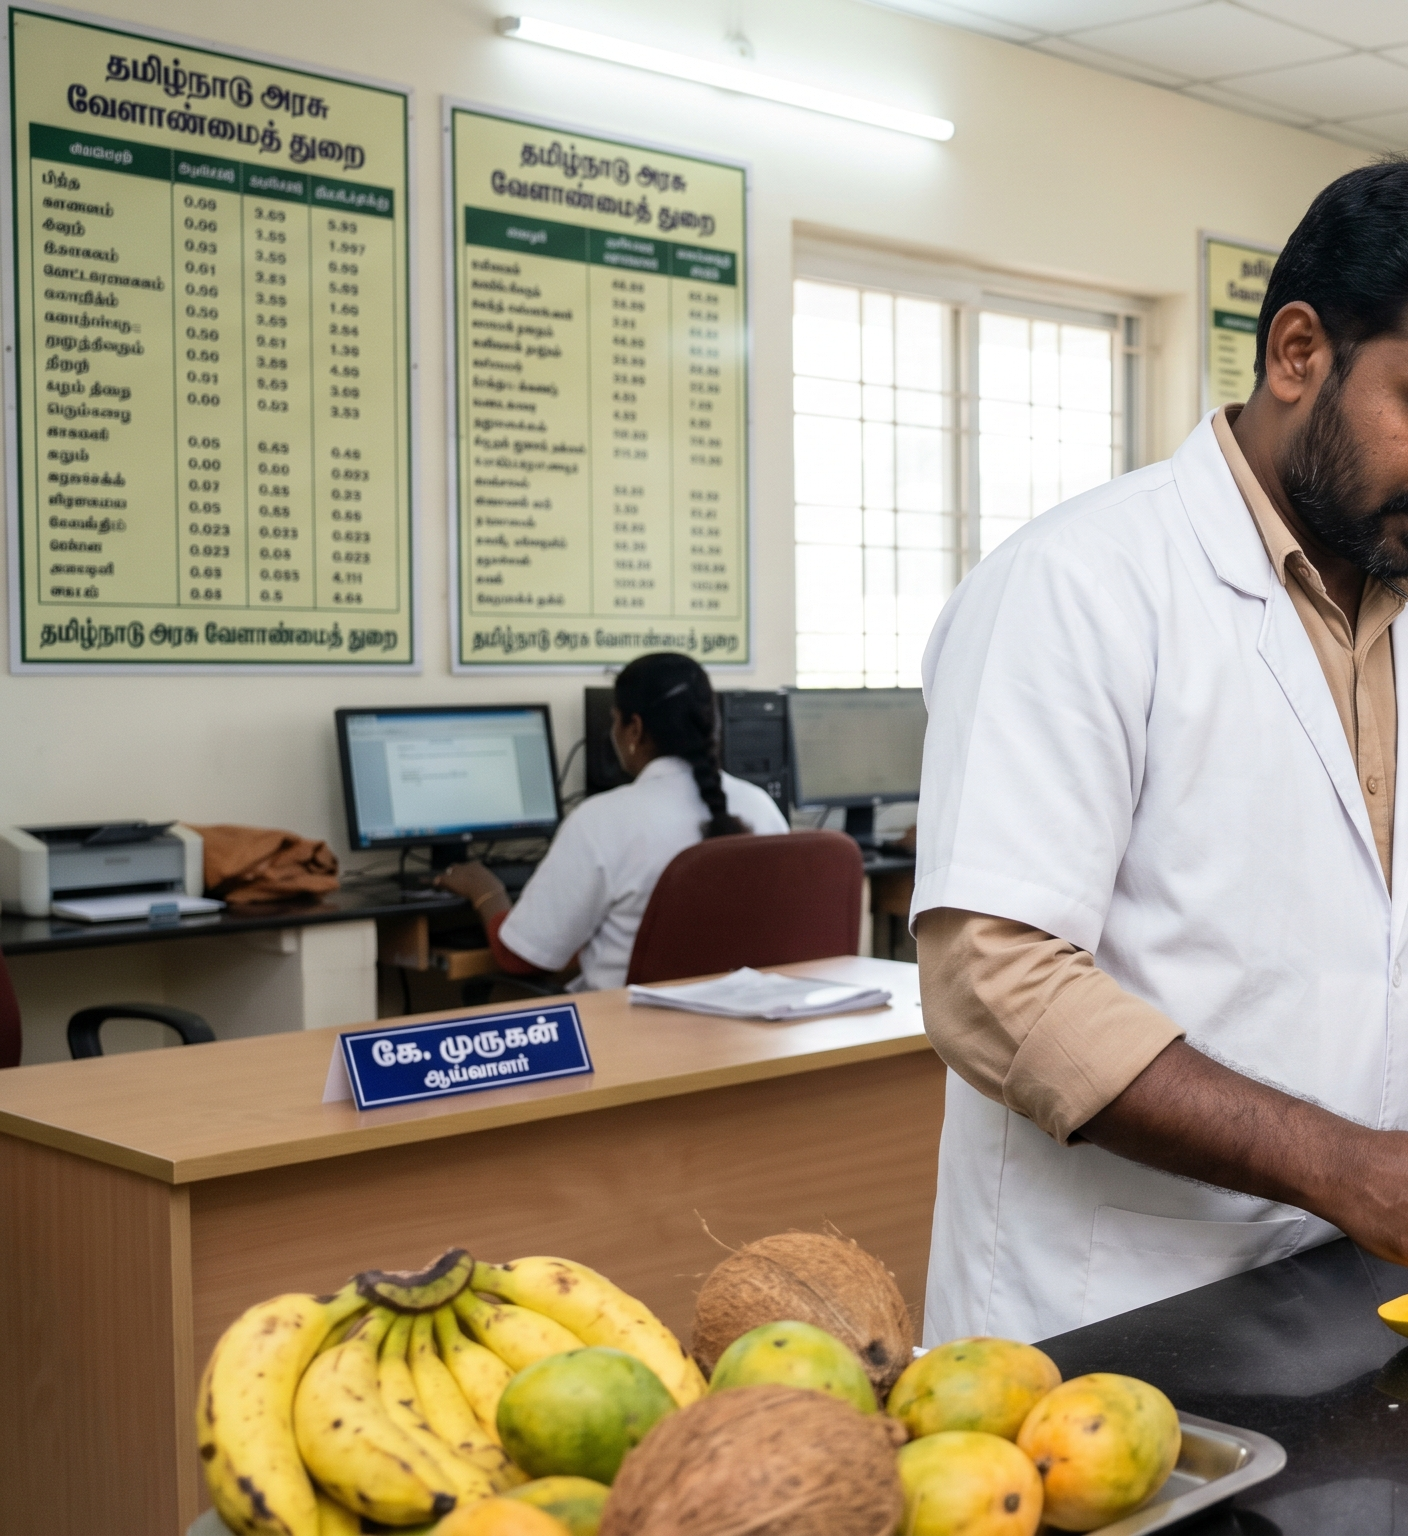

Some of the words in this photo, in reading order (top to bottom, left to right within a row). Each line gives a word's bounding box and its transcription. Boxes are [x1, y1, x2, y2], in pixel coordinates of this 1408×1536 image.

[106, 54, 253, 108] தமிழ்நாடு
[261, 85, 330, 120] அரசு
[68, 83, 281, 152] வேளாண்மைத்
[290, 132, 365, 171] துறை
[520, 141, 630, 186] தமிழ்நாடு
[636, 165, 687, 193] அரசு
[491, 170, 651, 223] வேளாண்மைத்
[657, 206, 716, 237] துறை
[189, 522, 230, 537] 0.023
[189, 544, 230, 559] 0.023
[40, 617, 145, 650] தமிழ்நாடு
[149, 621, 200, 649] அரசு
[205, 621, 343, 651] வேளாண்மைத்
[348, 628, 398, 652] துறை
[371, 1038, 432, 1068] கே.
[439, 1015, 559, 1064] முருகன்
[424, 1053, 529, 1090] ஆய்வாளர்
